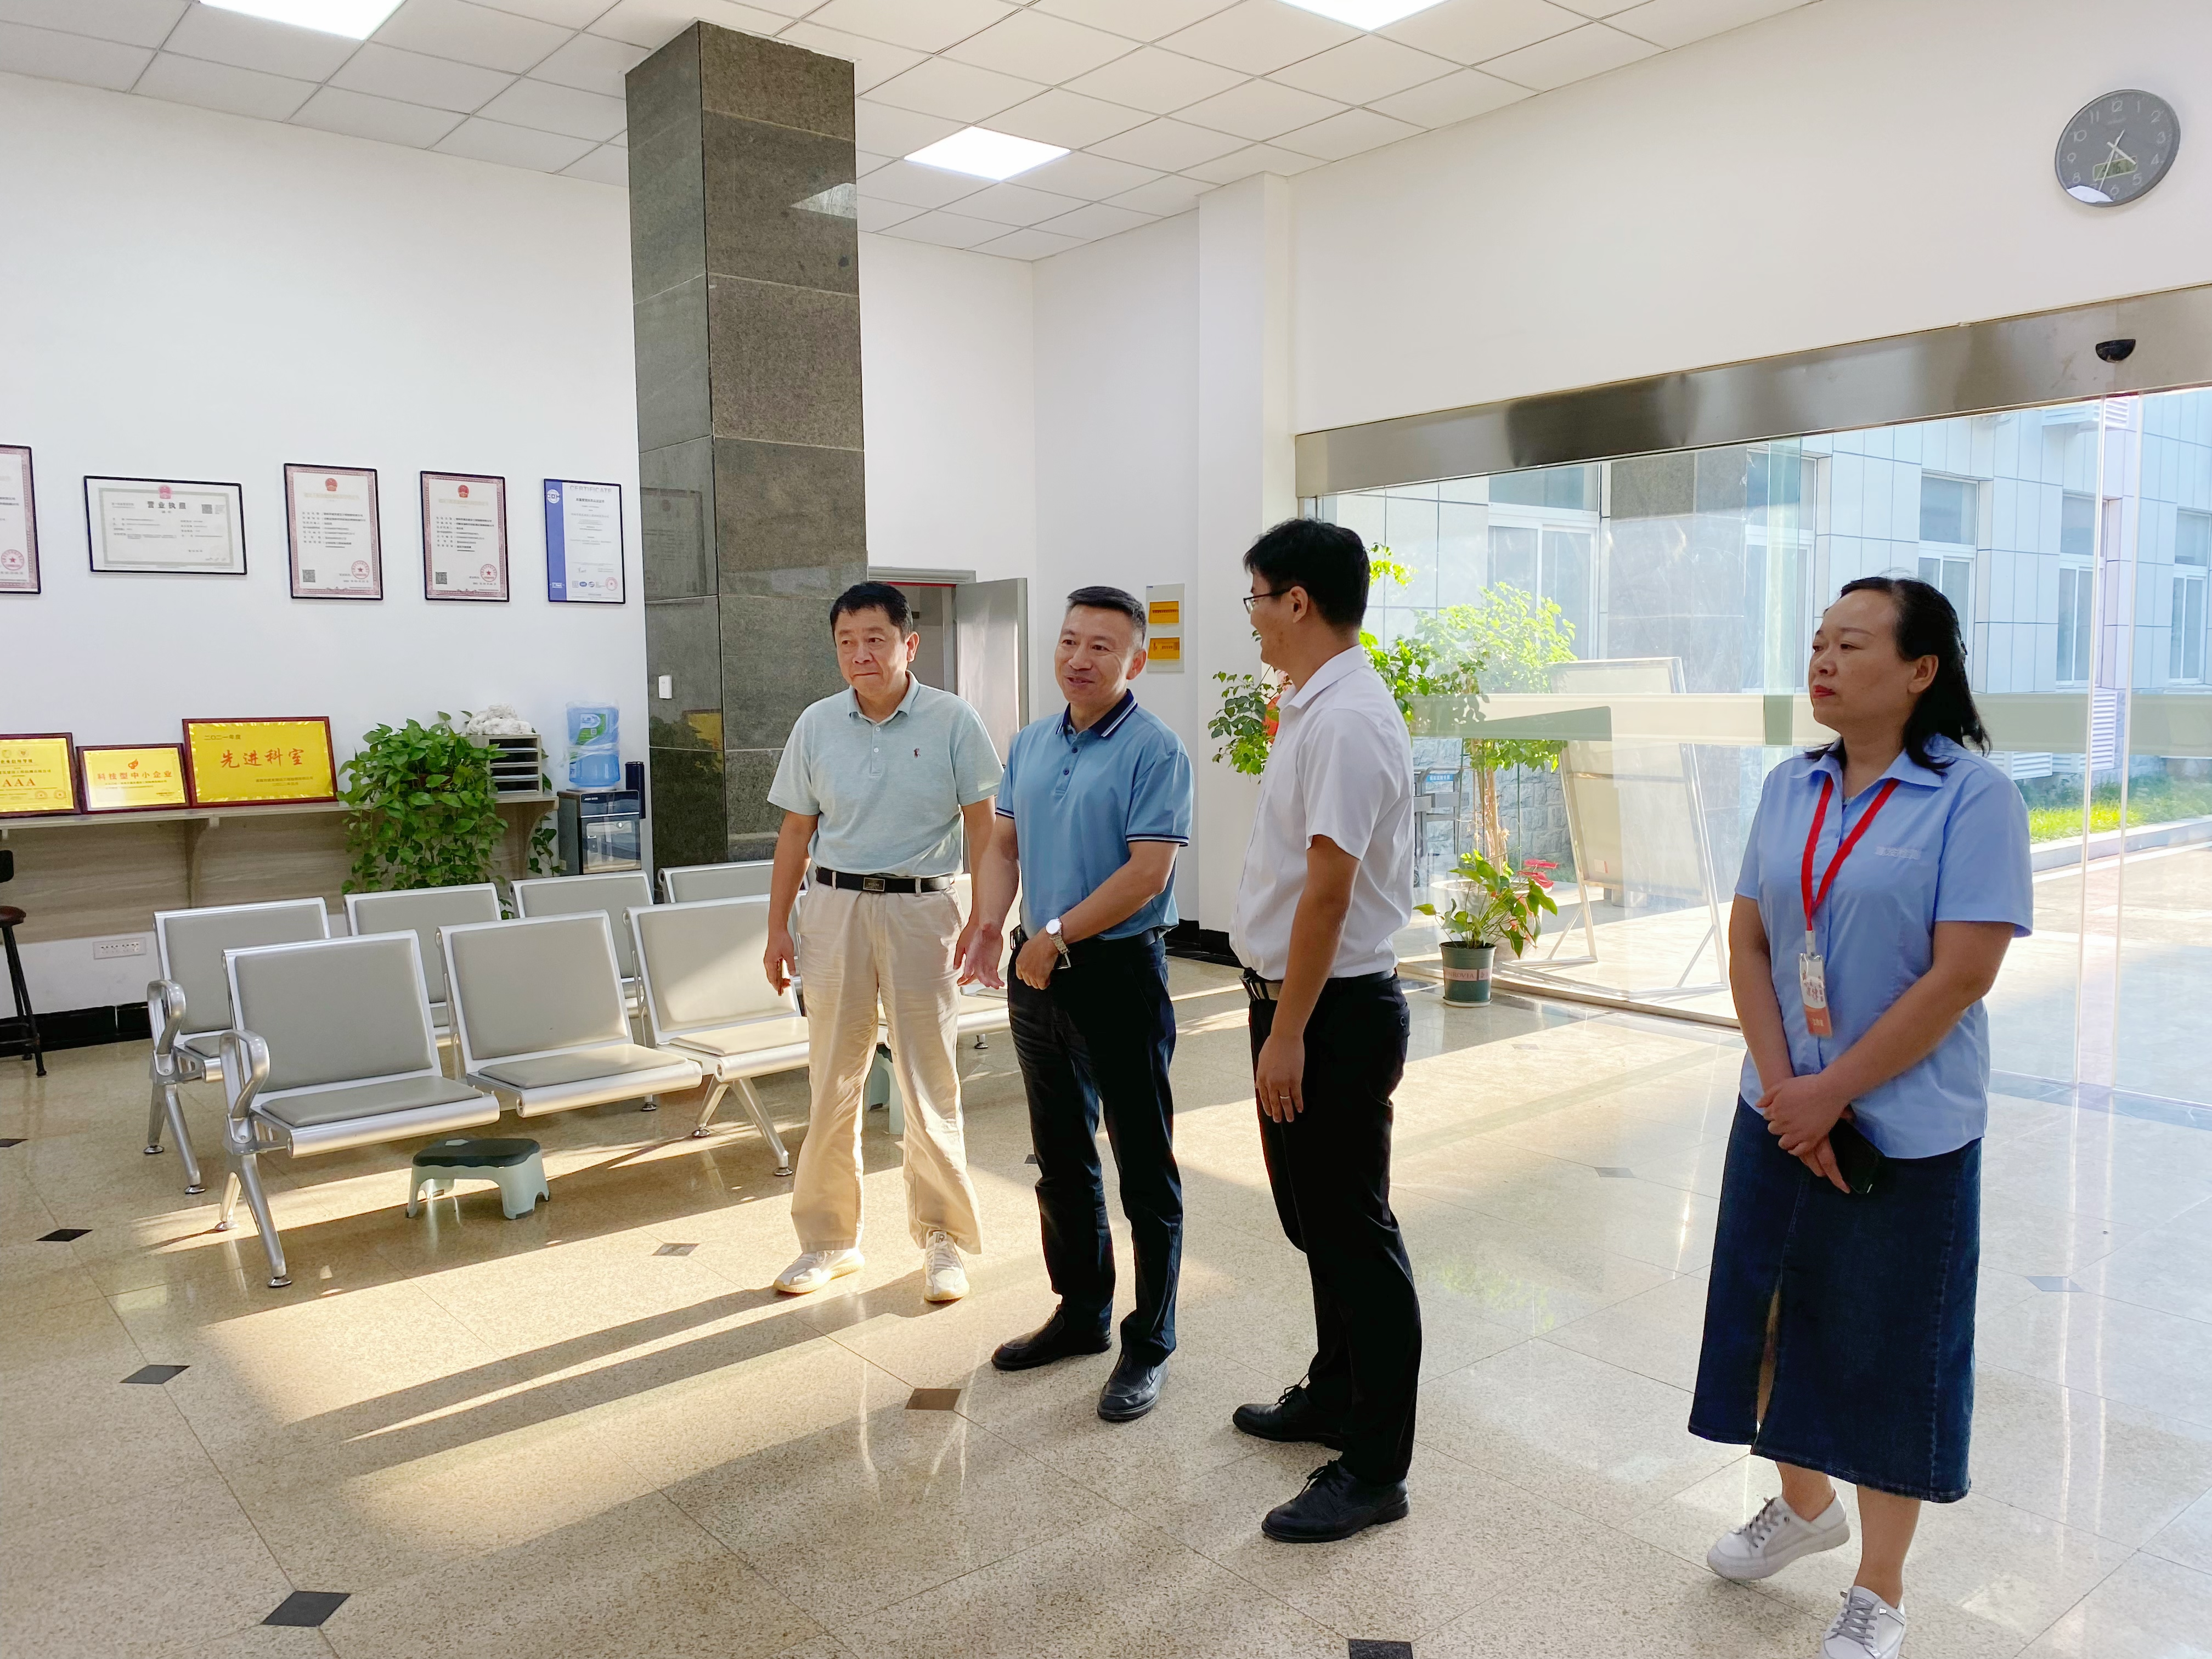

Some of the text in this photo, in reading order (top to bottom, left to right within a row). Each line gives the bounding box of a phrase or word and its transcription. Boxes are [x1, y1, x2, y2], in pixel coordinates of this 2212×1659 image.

[2112, 99, 2123, 112] 12
[2137, 100, 2141, 113] 1
[2089, 109, 2100, 124] 11
[2151, 110, 2161, 123] 2
[2073, 129, 2087, 142] 10
[2157, 132, 2166, 144] 3
[2067, 152, 2076, 164] 9
[2151, 153, 2160, 166] 4
[2072, 172, 2081, 183] 8
[2132, 173, 2142, 185] 5
[2110, 184, 2120, 196] 6
[569, 485, 612, 494] CERTIFICATE
[147, 501, 187, 510] 营业执照
[220, 747, 304, 769] 先进科室
[97, 770, 172, 781] 科技型中小企业
